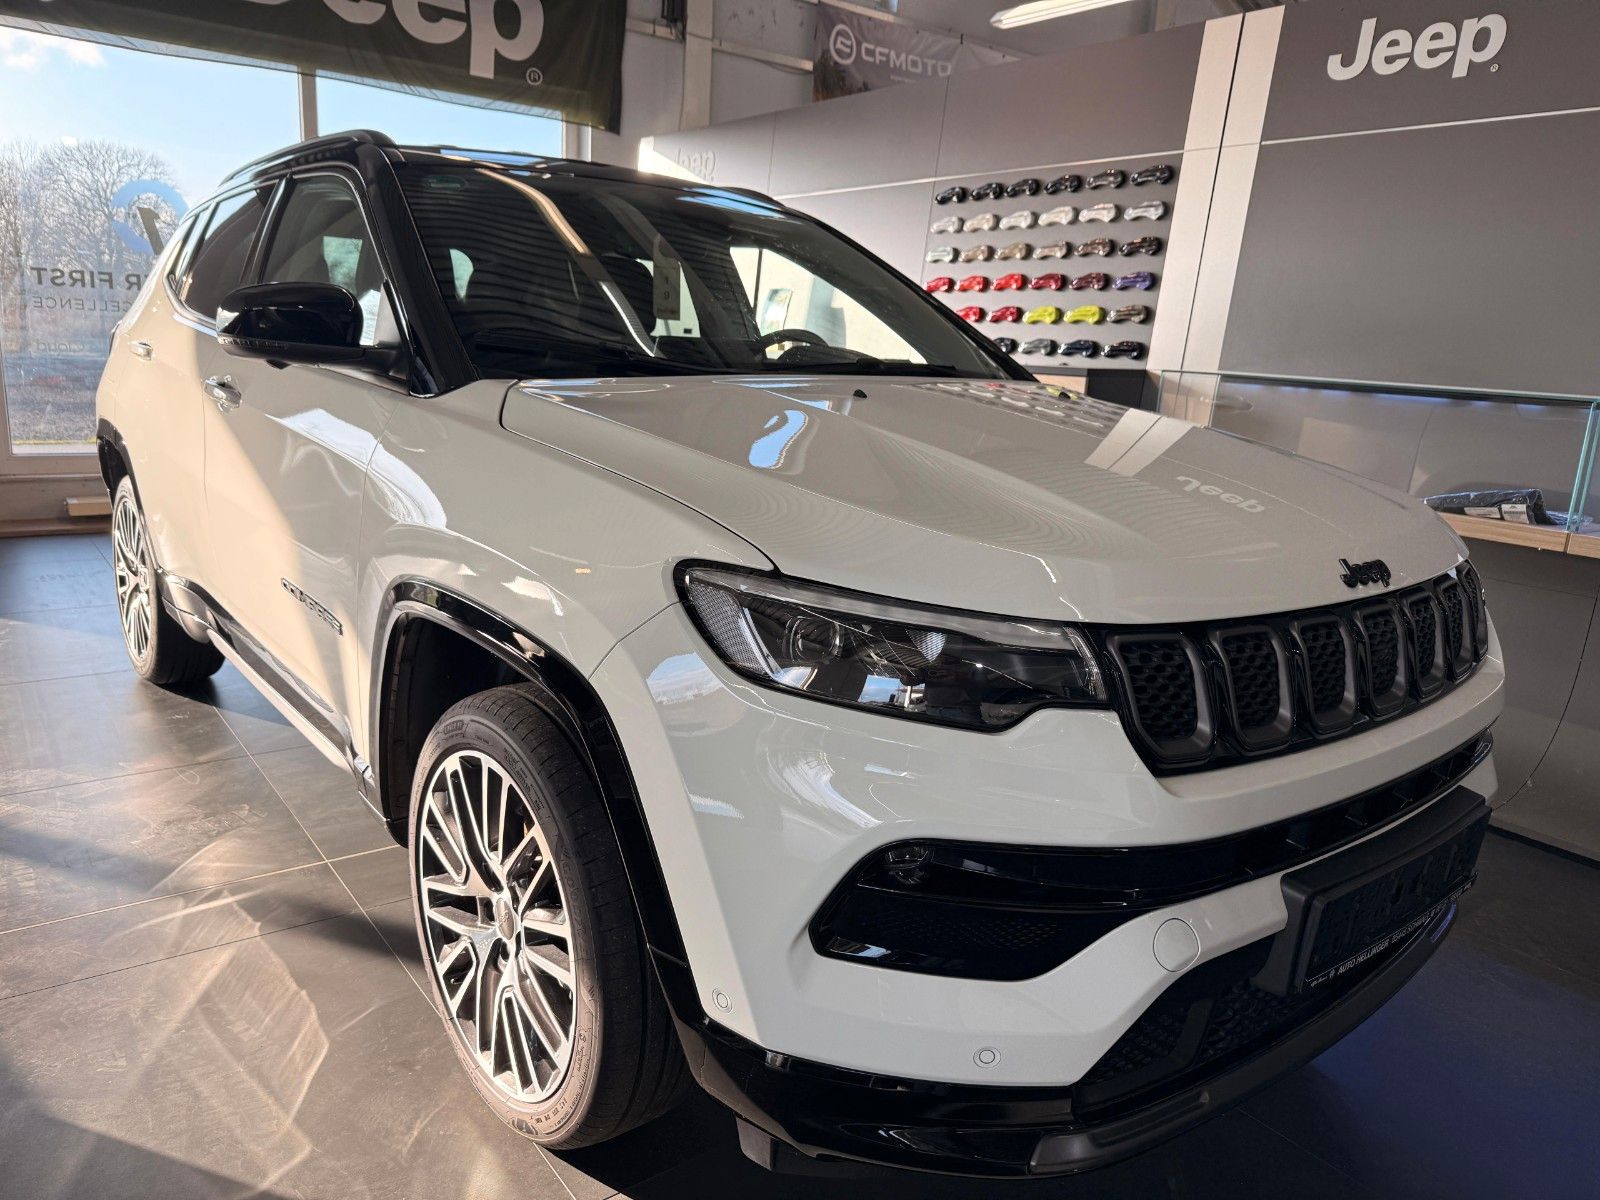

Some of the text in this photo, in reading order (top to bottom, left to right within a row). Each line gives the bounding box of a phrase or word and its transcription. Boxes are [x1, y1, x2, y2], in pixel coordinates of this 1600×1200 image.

[860, 41, 953, 78] CFMOTO
[1326, 13, 1508, 81] Jeep
[1339, 558, 1392, 588] Jeep
